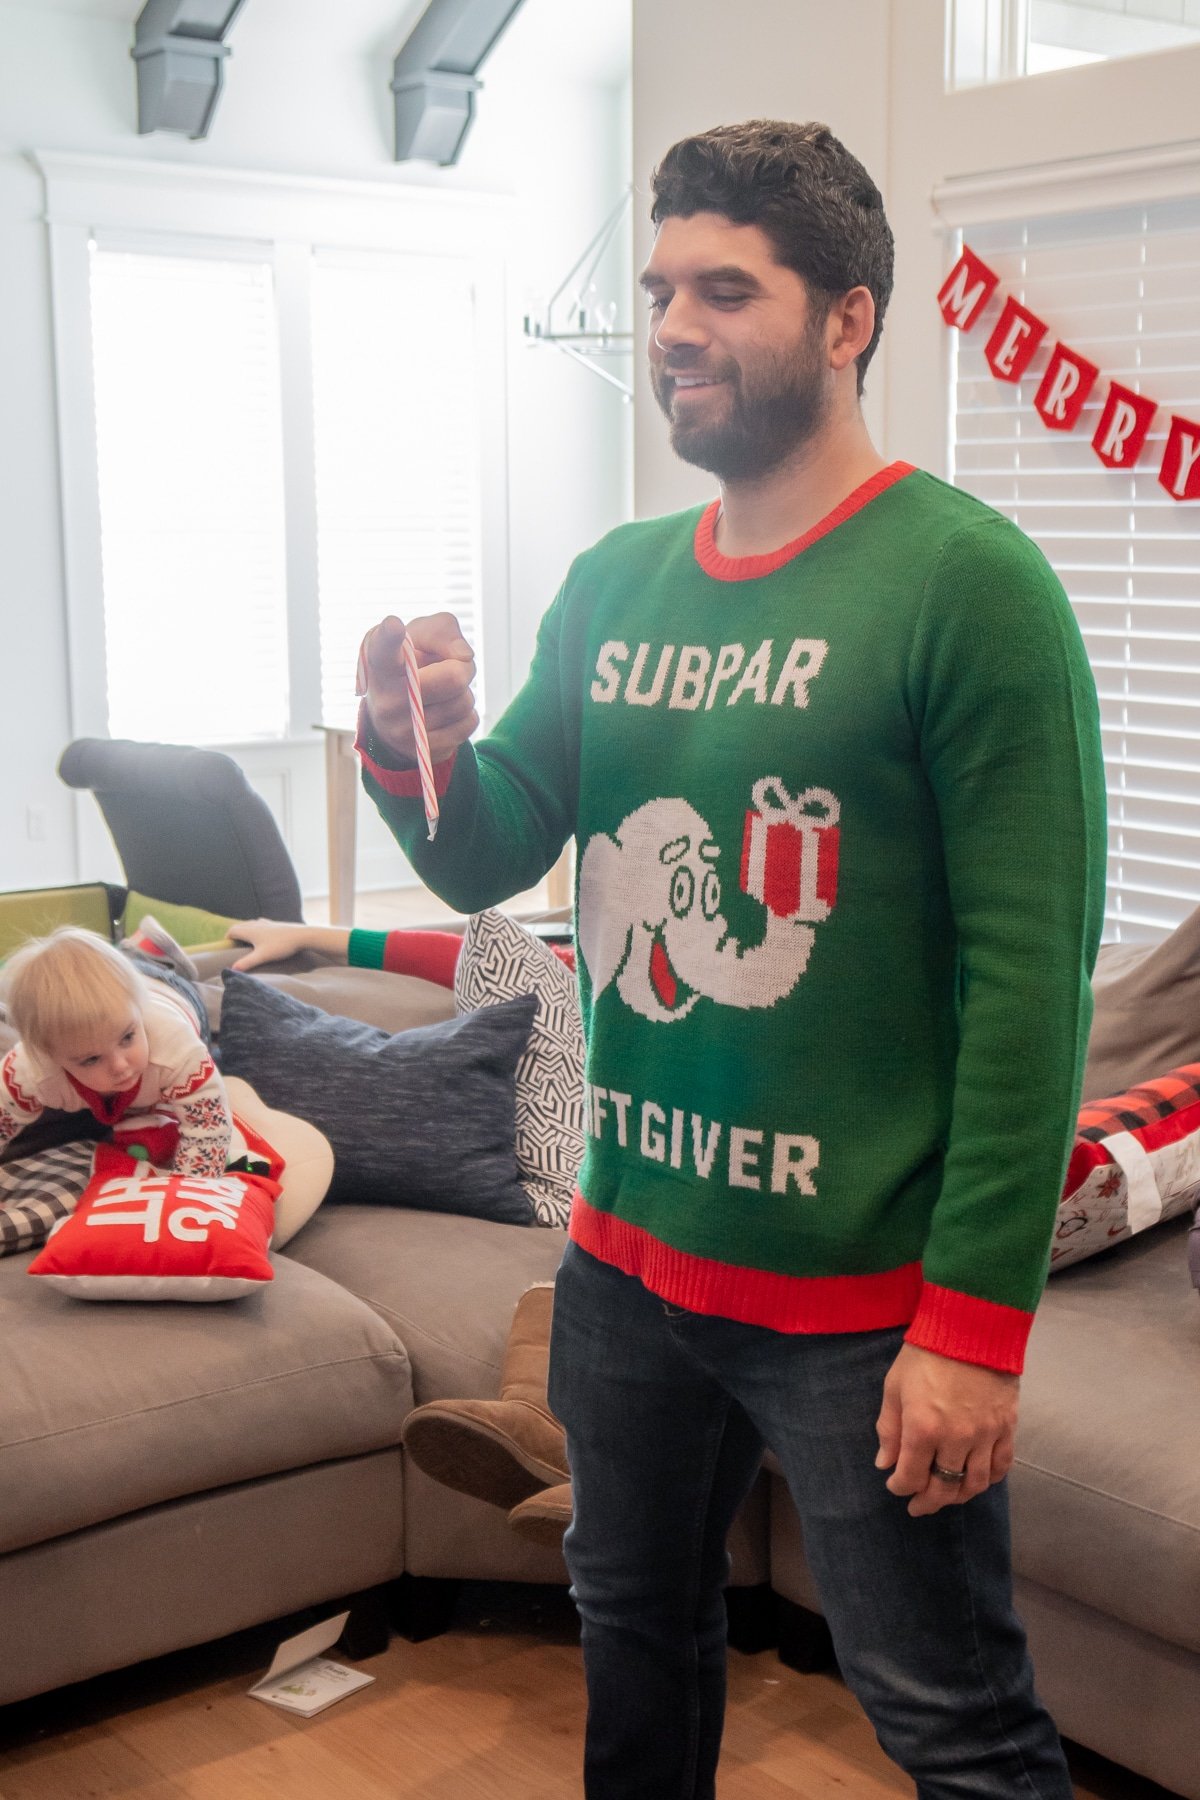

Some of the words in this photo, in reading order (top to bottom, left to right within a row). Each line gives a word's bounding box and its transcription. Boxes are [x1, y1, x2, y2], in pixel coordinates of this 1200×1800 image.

[940, 263, 1200, 496] MERRY
[590, 638, 829, 711] SUBPAR
[86, 1176, 170, 1243] HT
